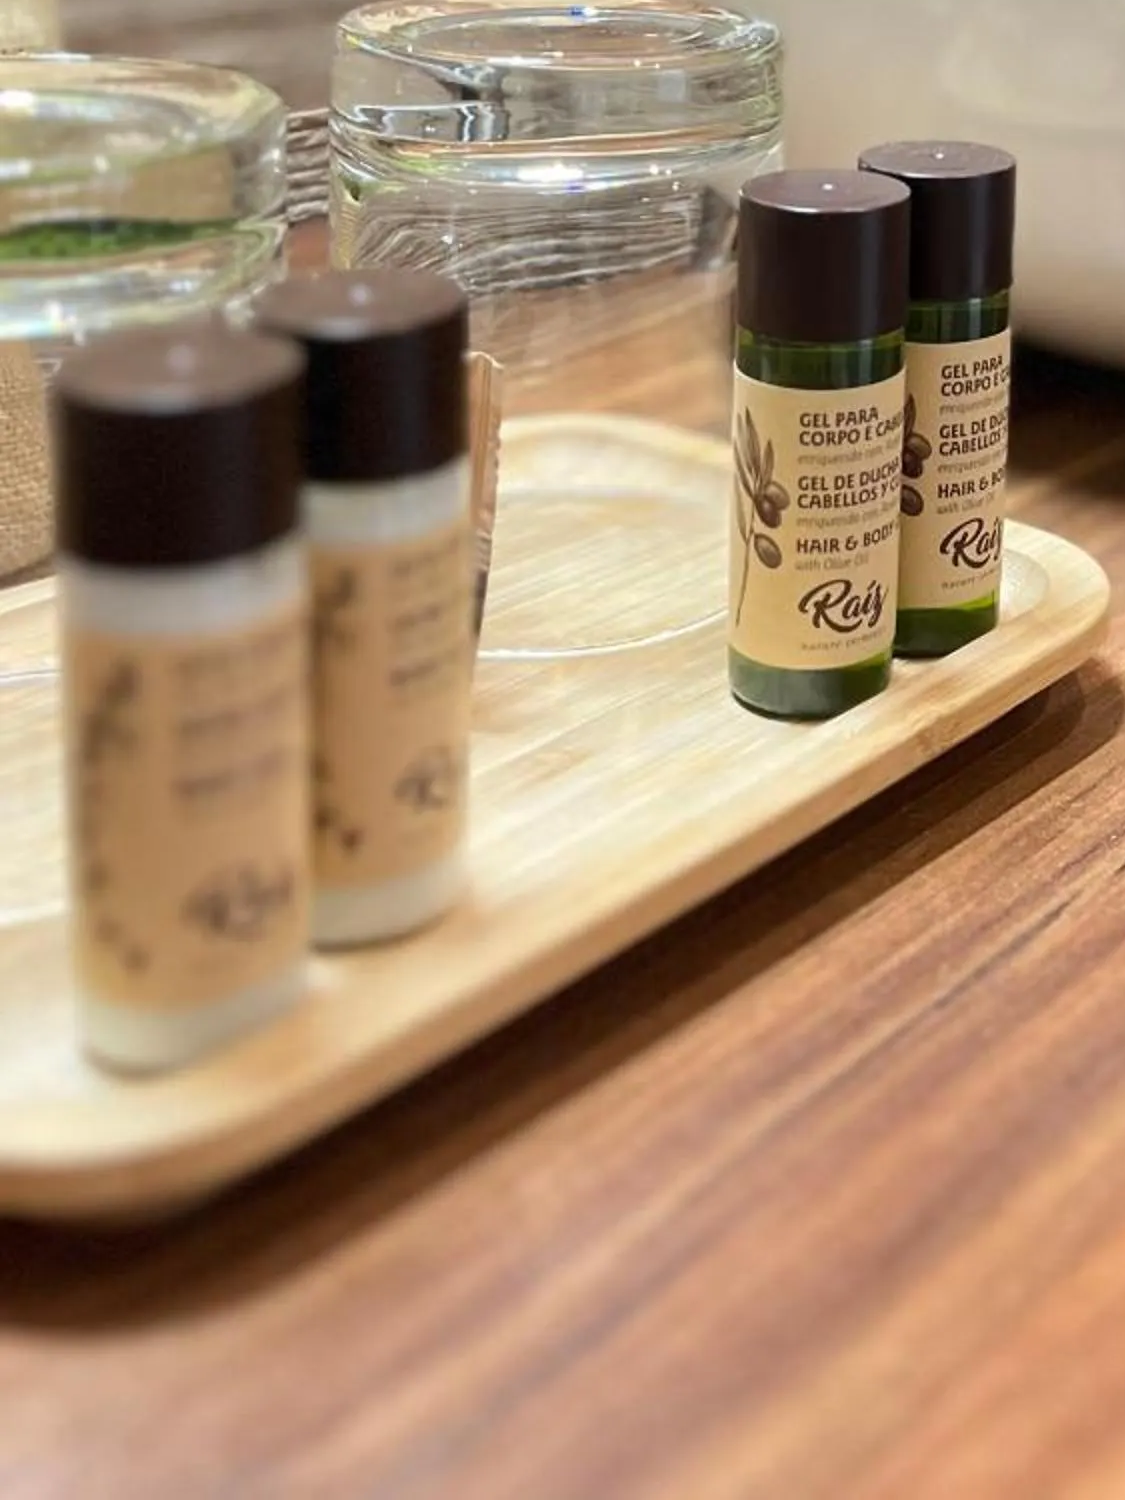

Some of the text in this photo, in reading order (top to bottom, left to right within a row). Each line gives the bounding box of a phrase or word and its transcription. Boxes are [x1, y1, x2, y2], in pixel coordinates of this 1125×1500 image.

[941, 364, 969, 380] GEL
[941, 376, 991, 396] CORPO
[799, 407, 879, 428] GEL PARA
[800, 429, 860, 447] CORPO
[865, 426, 872, 441] E
[940, 424, 967, 439] GEL
[971, 418, 987, 435] DE
[939, 430, 1001, 456] CABELLOS
[798, 476, 828, 491] GEL
[834, 473, 855, 490] DE
[937, 481, 975, 498] HAIR
[797, 486, 877, 509] CABELLOS
[797, 538, 840, 553] HAIR
[845, 536, 858, 550] &
